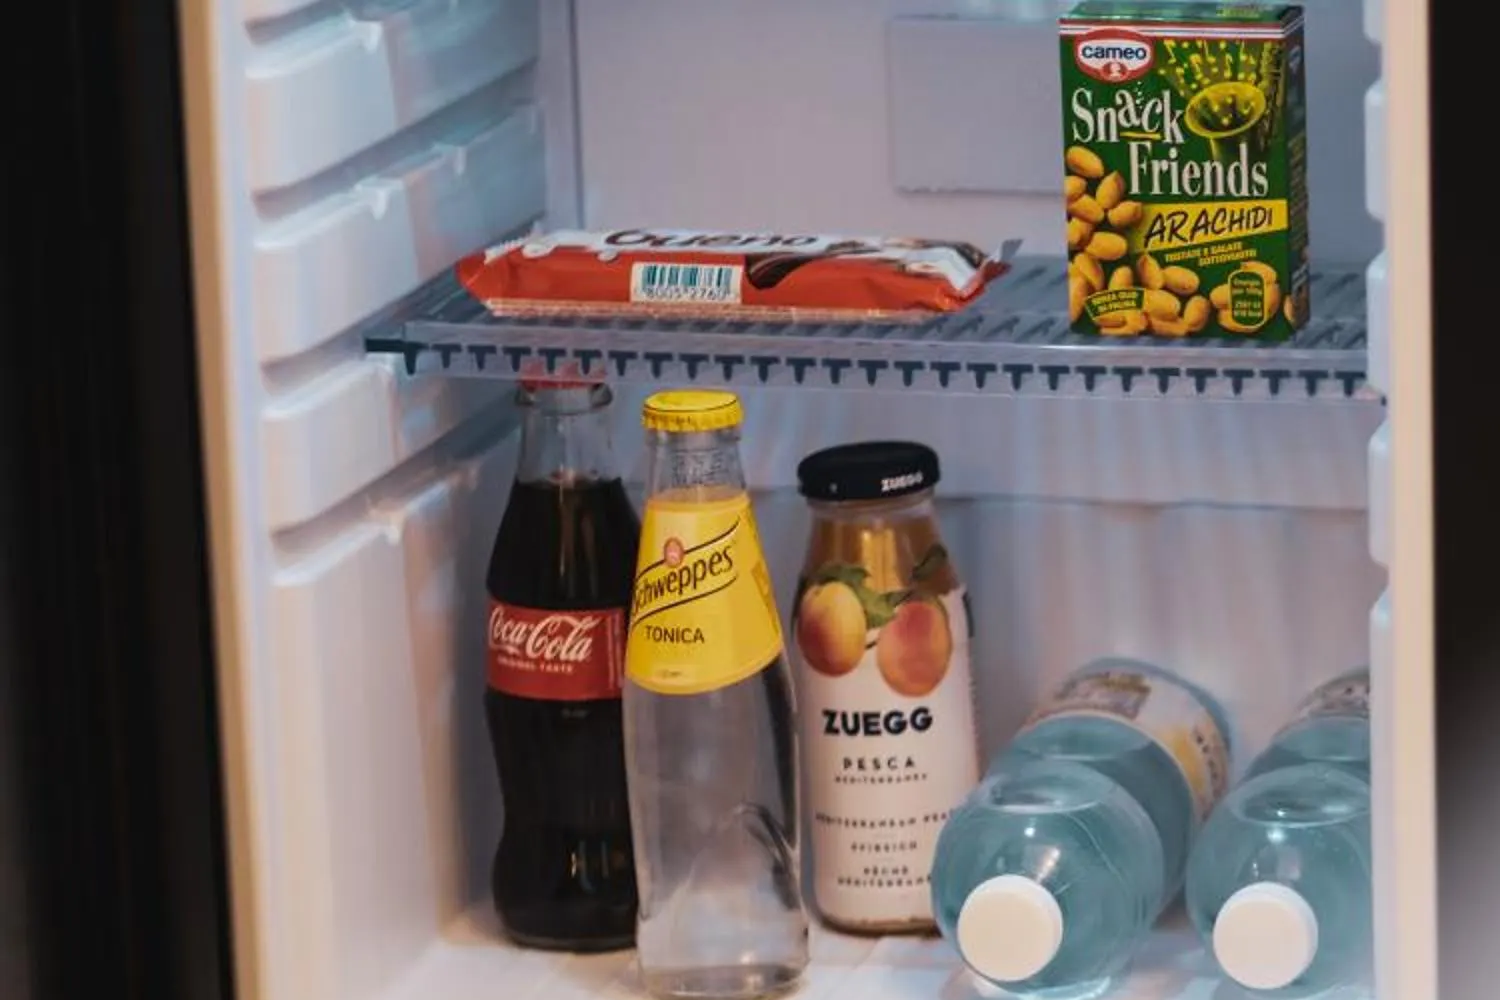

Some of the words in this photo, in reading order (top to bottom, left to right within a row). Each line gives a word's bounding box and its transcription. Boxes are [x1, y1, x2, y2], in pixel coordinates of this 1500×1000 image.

[1081, 44, 1147, 60] cameo
[1071, 87, 1184, 144] Snack
[1128, 141, 1269, 197] Friends
[1144, 206, 1273, 248] ARACHIDI
[881, 470, 924, 491] ZUEGG
[645, 625, 705, 644] TONICA
[821, 706, 934, 736] ZUEGG
[843, 756, 915, 771] PESCA
